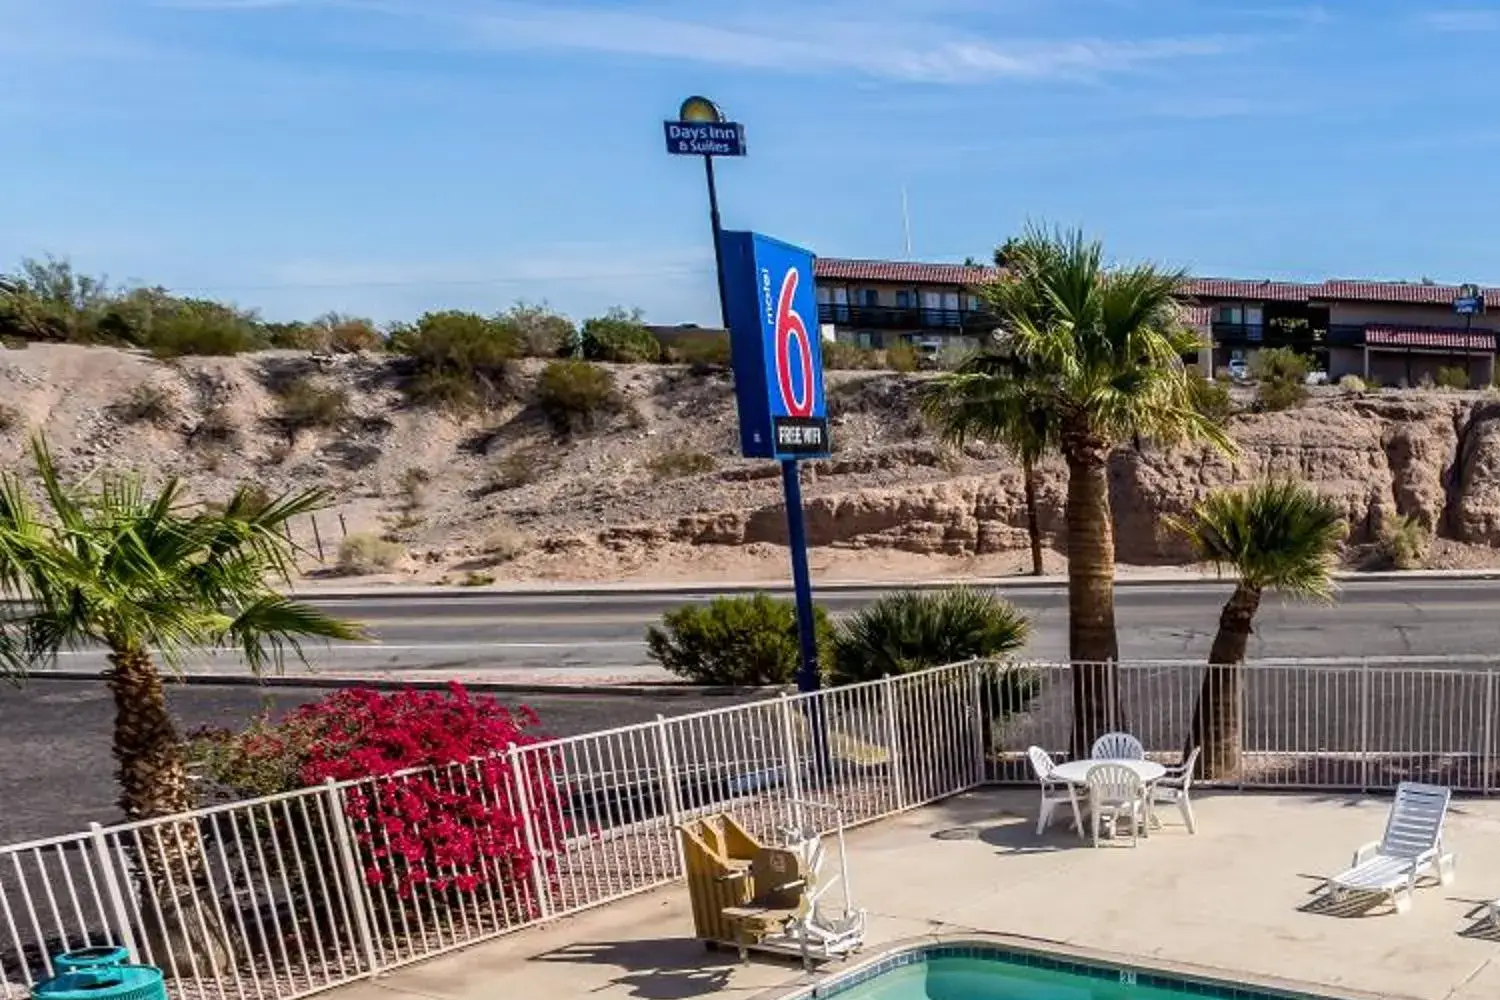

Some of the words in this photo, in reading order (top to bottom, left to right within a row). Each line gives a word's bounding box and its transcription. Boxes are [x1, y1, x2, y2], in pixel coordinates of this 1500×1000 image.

[669, 125, 708, 140] Days
[709, 126, 735, 139] Inn
[689, 140, 729, 152] Suites
[761, 268, 775, 325] motel
[776, 267, 814, 416] 6
[779, 426, 802, 445] FREE
